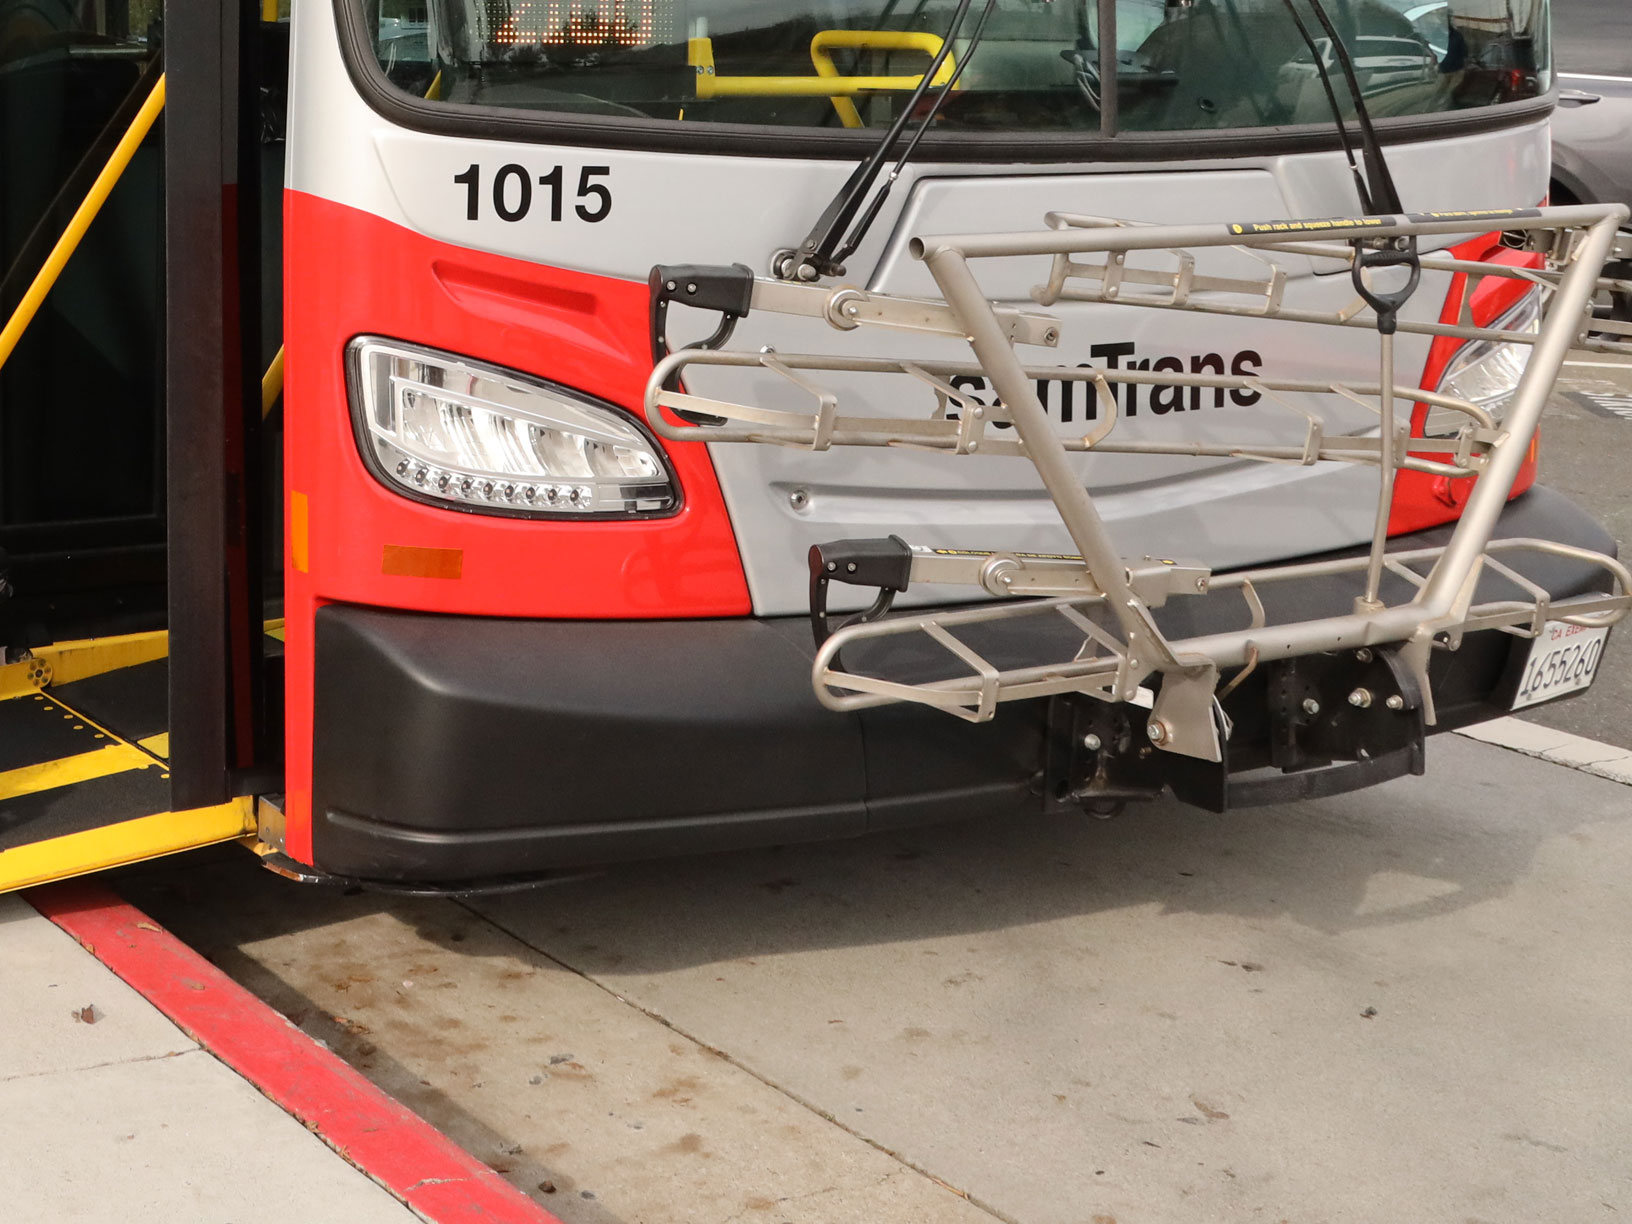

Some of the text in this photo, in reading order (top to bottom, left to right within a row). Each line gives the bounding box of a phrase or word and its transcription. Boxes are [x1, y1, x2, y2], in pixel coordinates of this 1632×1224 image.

[454, 163, 612, 223] 1015
[1253, 218, 1382, 232] Push rack and squeeze handle to lower
[945, 341, 1263, 429] smTrans
[1519, 637, 1602, 697] 1655260
